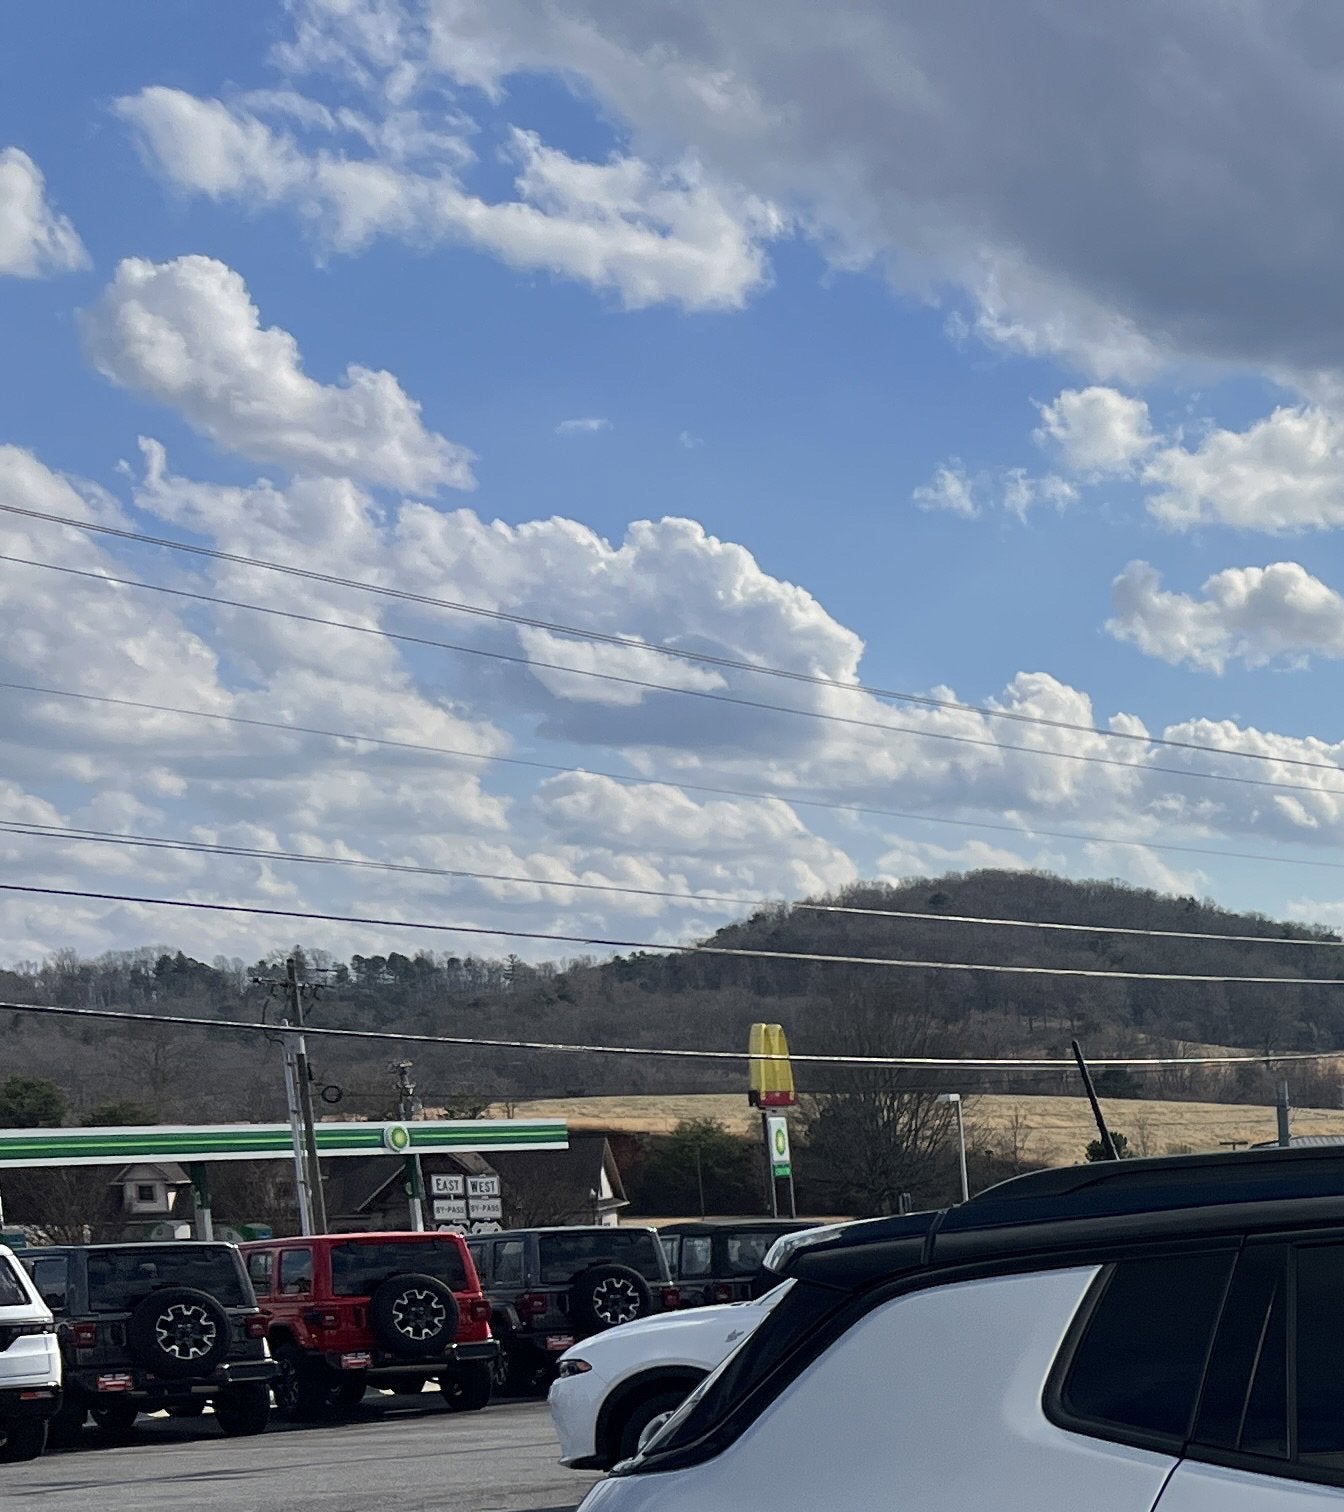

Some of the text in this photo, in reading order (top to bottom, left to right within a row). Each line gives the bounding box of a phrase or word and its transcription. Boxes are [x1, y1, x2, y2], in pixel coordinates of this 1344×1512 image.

[436, 1178, 459, 1191] EAST
[470, 1180, 495, 1193] WEST
[436, 1206, 464, 1214] BY-PASS
[470, 1204, 499, 1212] BY-PASS
